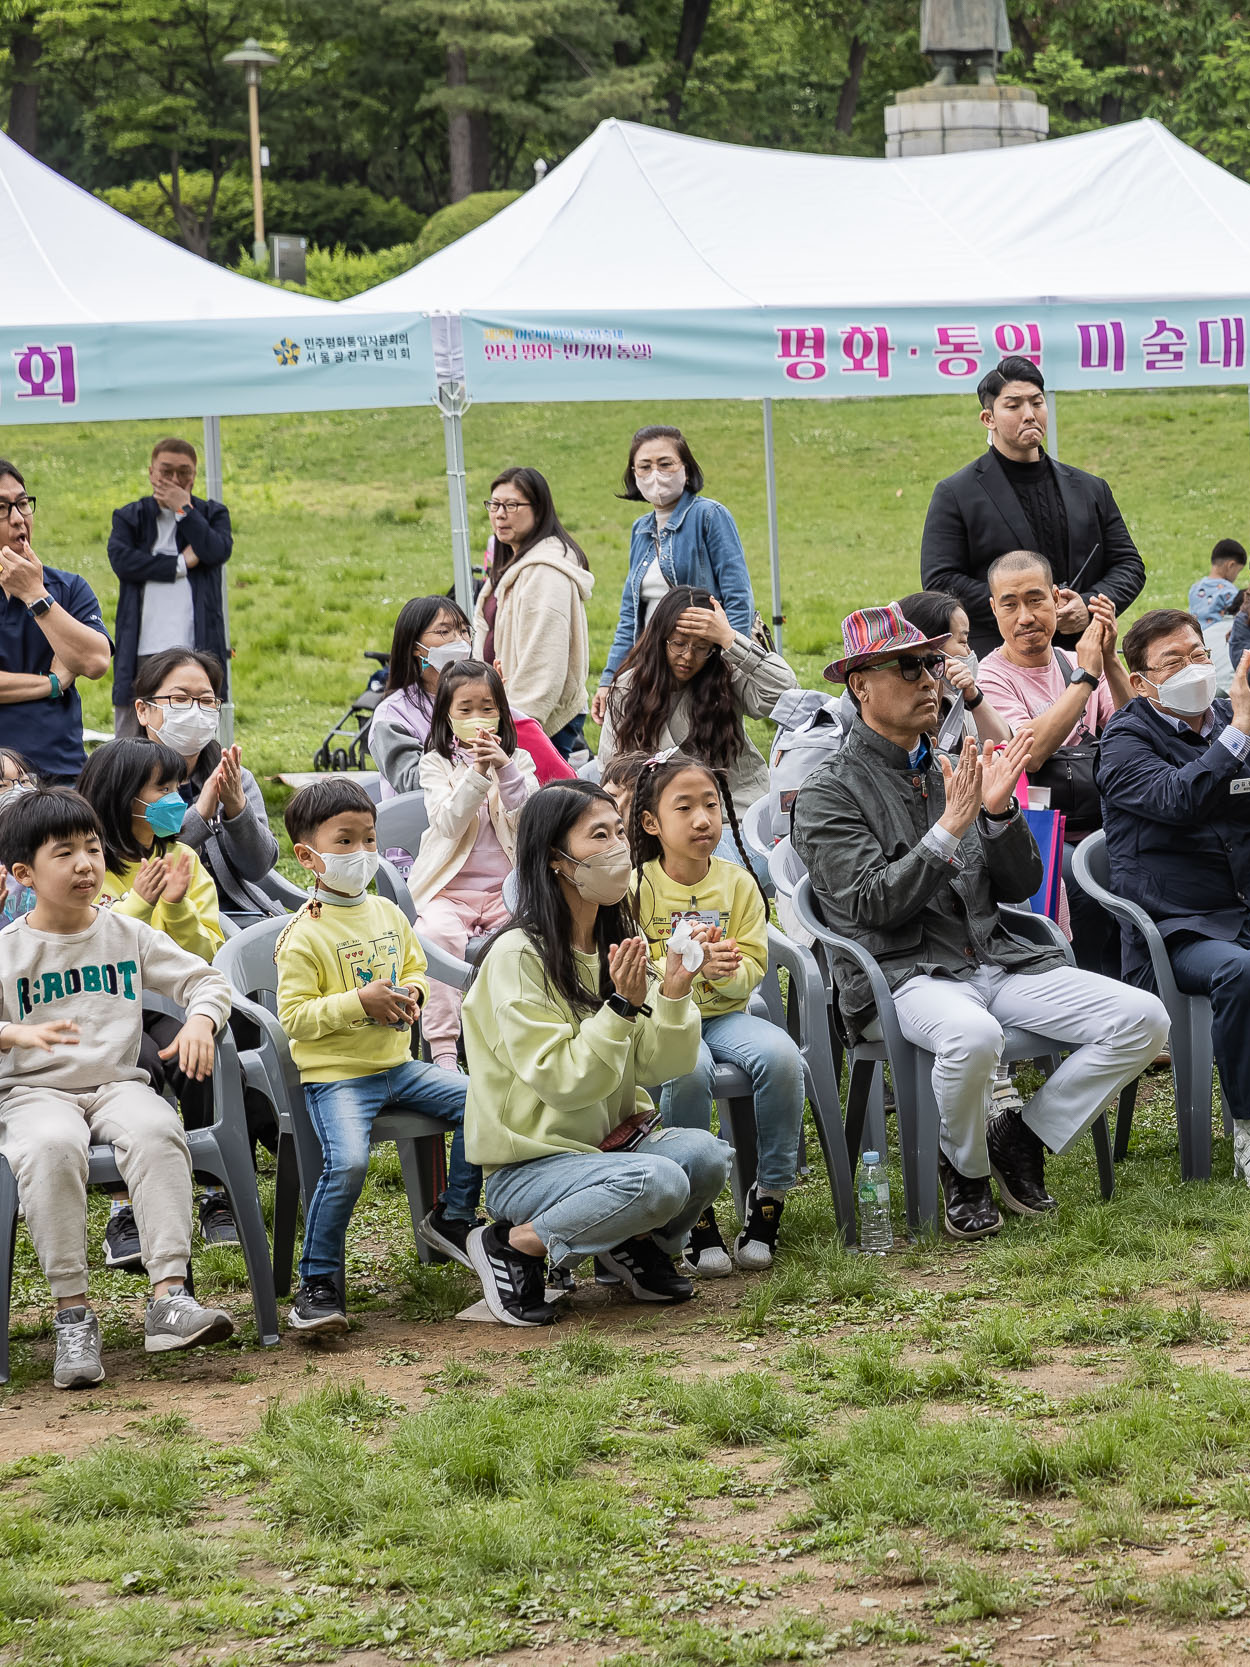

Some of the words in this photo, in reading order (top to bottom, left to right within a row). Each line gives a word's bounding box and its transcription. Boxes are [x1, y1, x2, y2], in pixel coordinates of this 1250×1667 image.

[304, 331, 409, 351] 민주평화통일자문회의
[305, 347, 411, 365] 서울광진구협의회
[484, 343, 517, 361] 안녕
